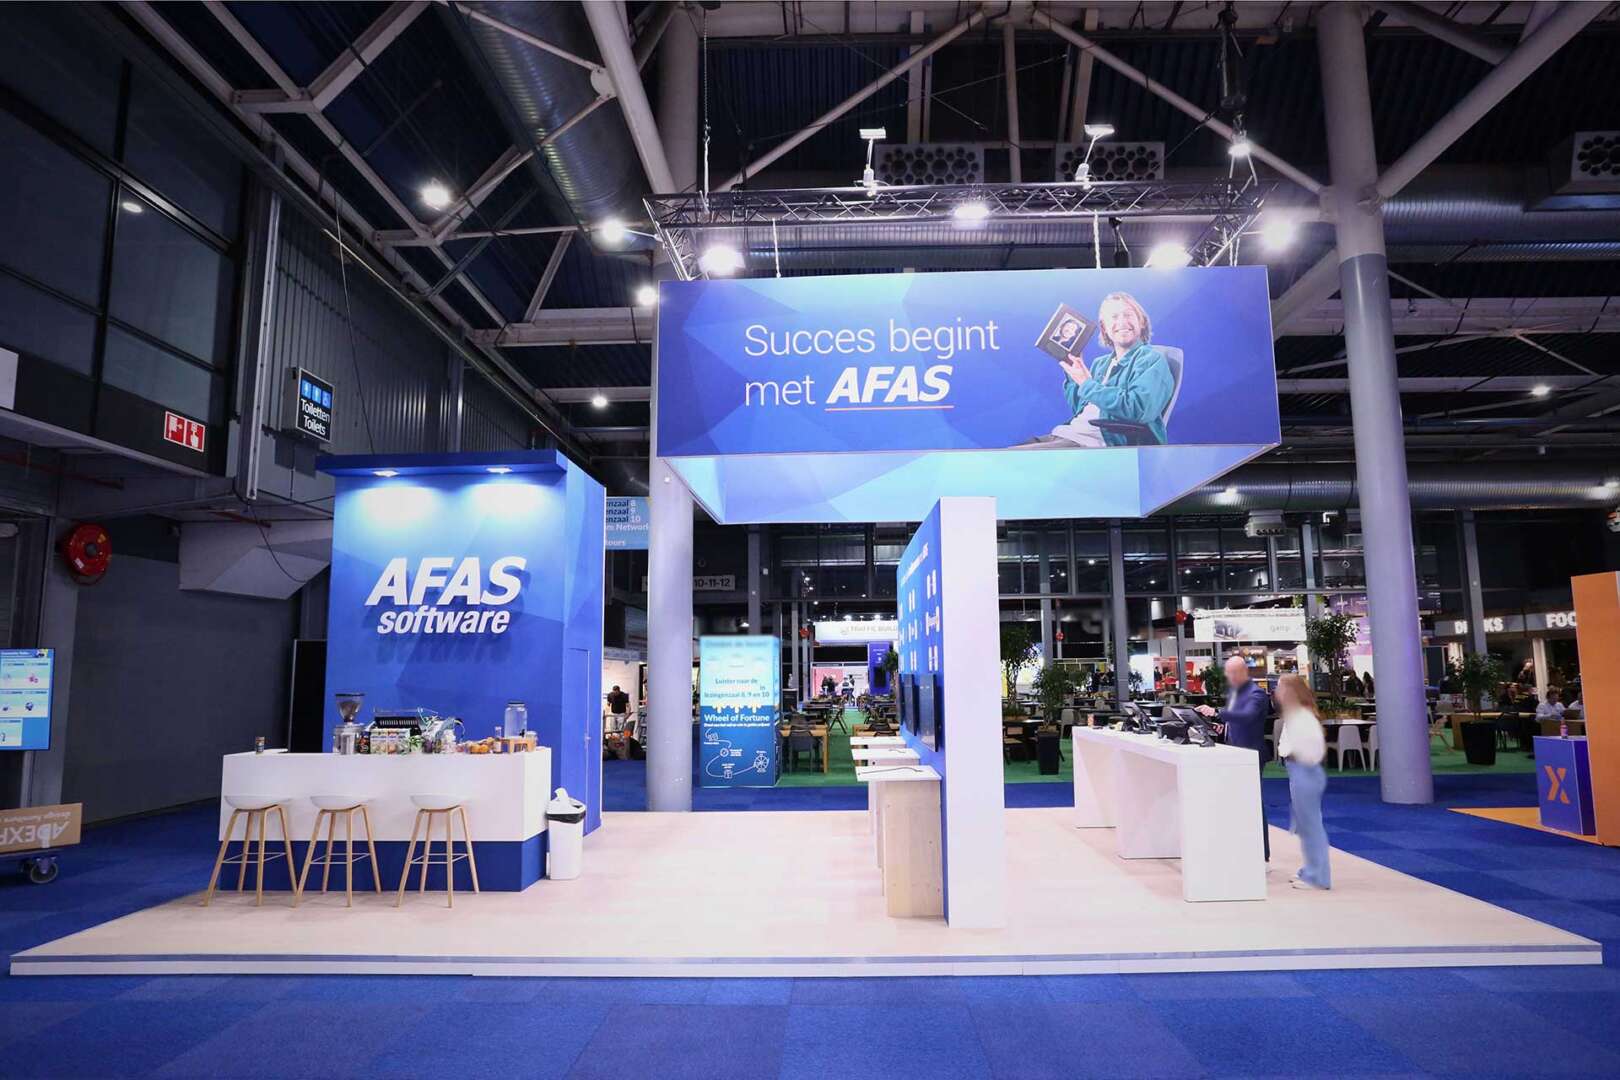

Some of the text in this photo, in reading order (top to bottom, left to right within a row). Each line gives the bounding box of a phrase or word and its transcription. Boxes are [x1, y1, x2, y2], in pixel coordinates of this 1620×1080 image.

[744, 317, 1000, 360] Succes begint
[744, 365, 953, 406] met AFAS
[301, 398, 330, 423] Toiletten
[304, 415, 326, 436] Toilets
[364, 556, 527, 606] AFAS
[377, 605, 510, 634] software
[1455, 617, 1503, 634] DKS
[704, 713, 770, 721] Wheel of Fortune
